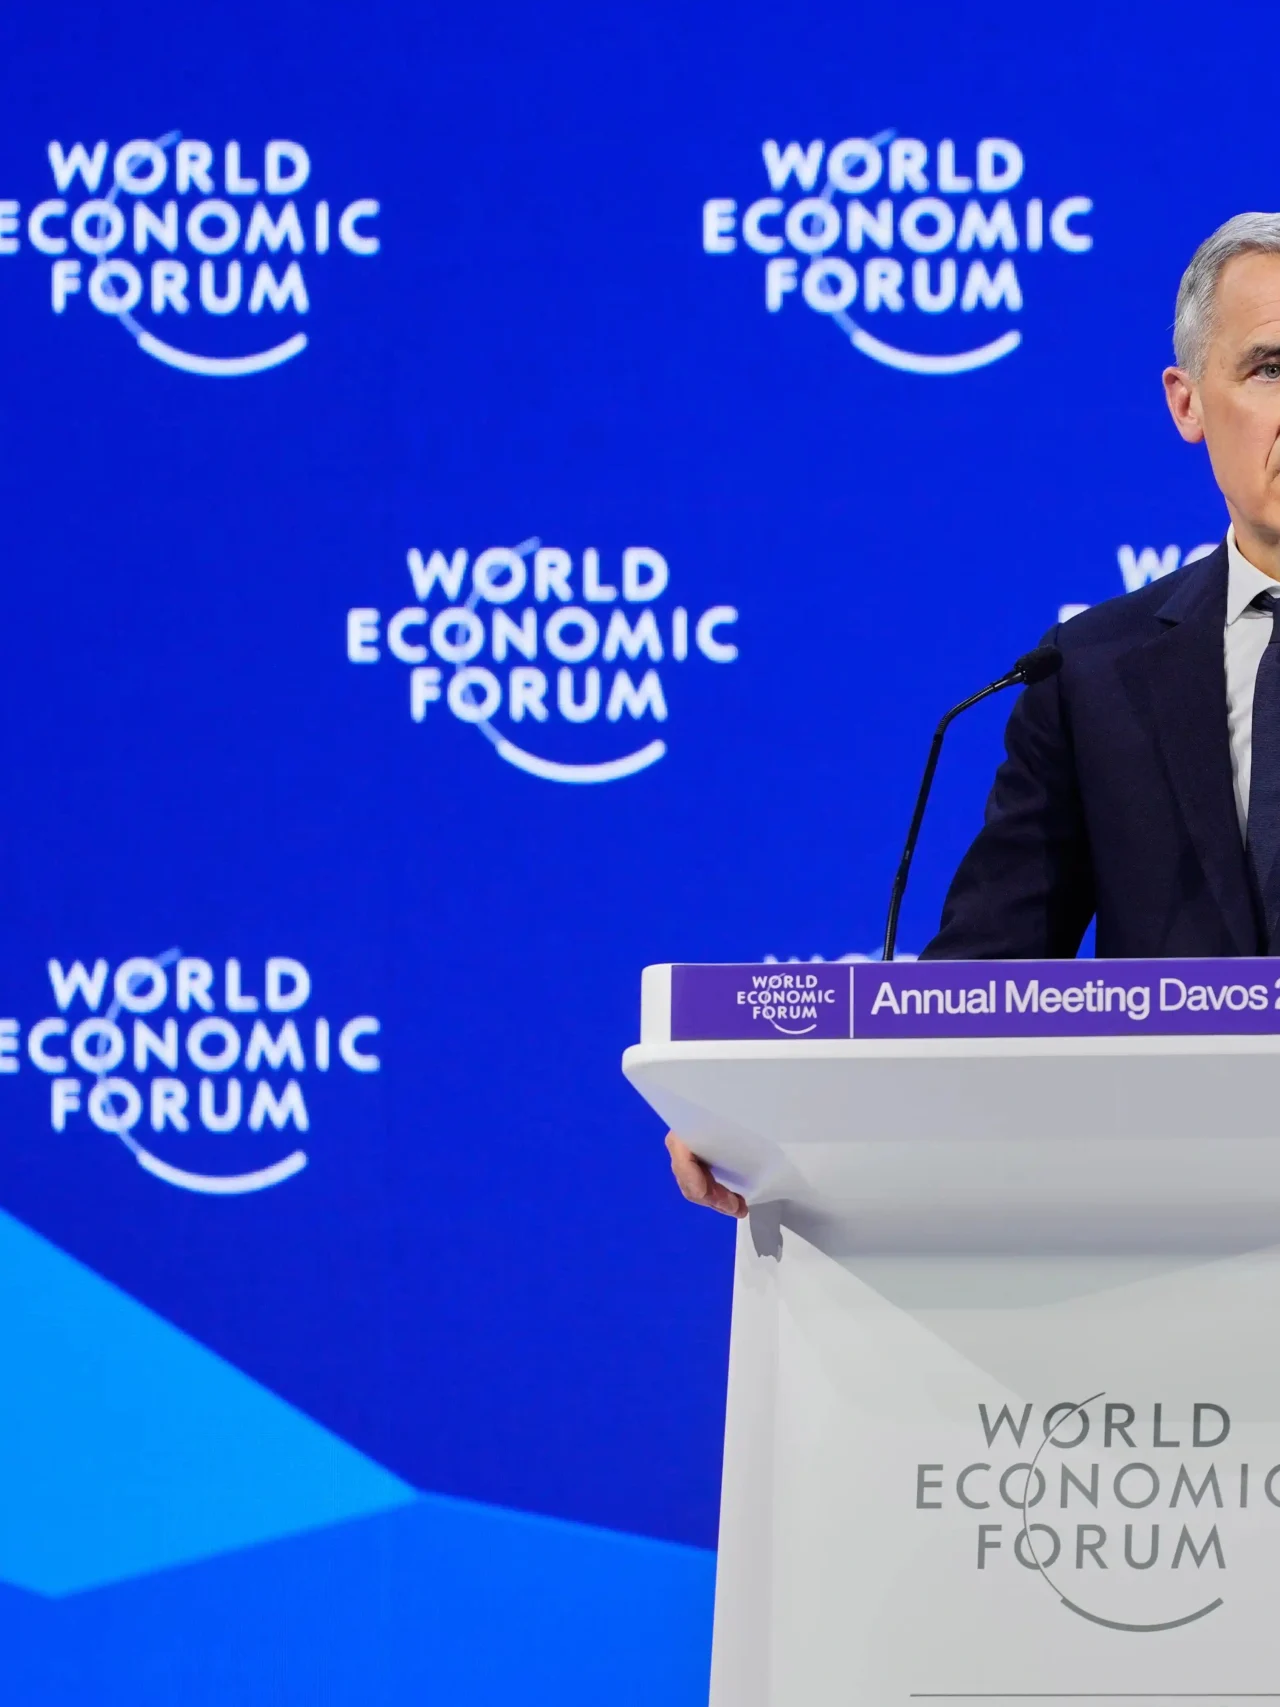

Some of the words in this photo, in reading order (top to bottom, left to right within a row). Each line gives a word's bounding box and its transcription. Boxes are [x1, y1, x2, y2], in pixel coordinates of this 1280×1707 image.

[48, 139, 311, 194] WORLD
[762, 137, 1025, 193] WORLD
[702, 196, 1091, 253] ECONOMIC
[51, 259, 310, 315] FORUM
[766, 257, 1023, 312] FORUM
[407, 547, 670, 603] WORLD
[347, 605, 737, 663] ECONOMIC
[410, 666, 668, 723] FORUM
[49, 957, 312, 1013] WORLD
[737, 989, 835, 1005] ECONOMIC
[752, 974, 818, 989] WORLD
[870, 980, 996, 1015] Annual
[1004, 979, 1151, 1021] Meeting
[1159, 977, 1268, 1011] Davos
[753, 1005, 818, 1020] FORUM
[51, 1077, 310, 1132] FORUM
[978, 1401, 1231, 1449] WORLD
[977, 1523, 1227, 1570] FORUM
